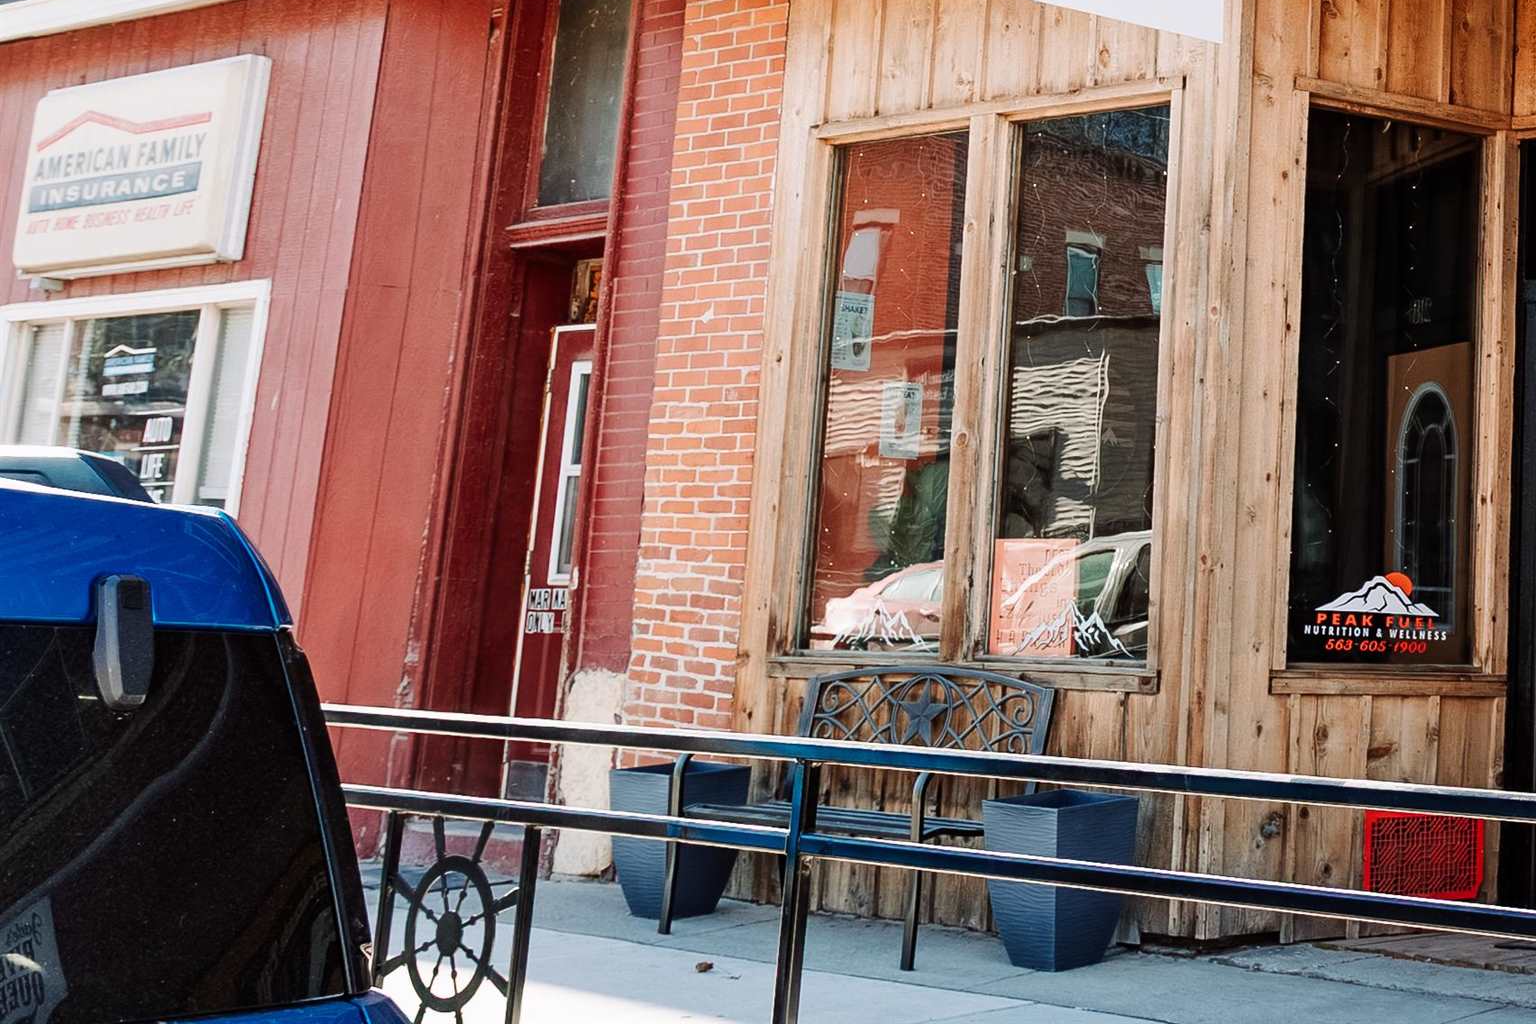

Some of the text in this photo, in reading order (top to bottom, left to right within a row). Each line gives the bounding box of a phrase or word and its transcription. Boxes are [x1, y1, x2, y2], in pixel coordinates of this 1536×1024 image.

[34, 132, 208, 181] AMERICAN FAMILY
[39, 171, 187, 205] INSURANCE
[1304, 625, 1447, 641] NUTRITION & WELLNESS
[1317, 613, 1435, 629] PEAK FUEL
